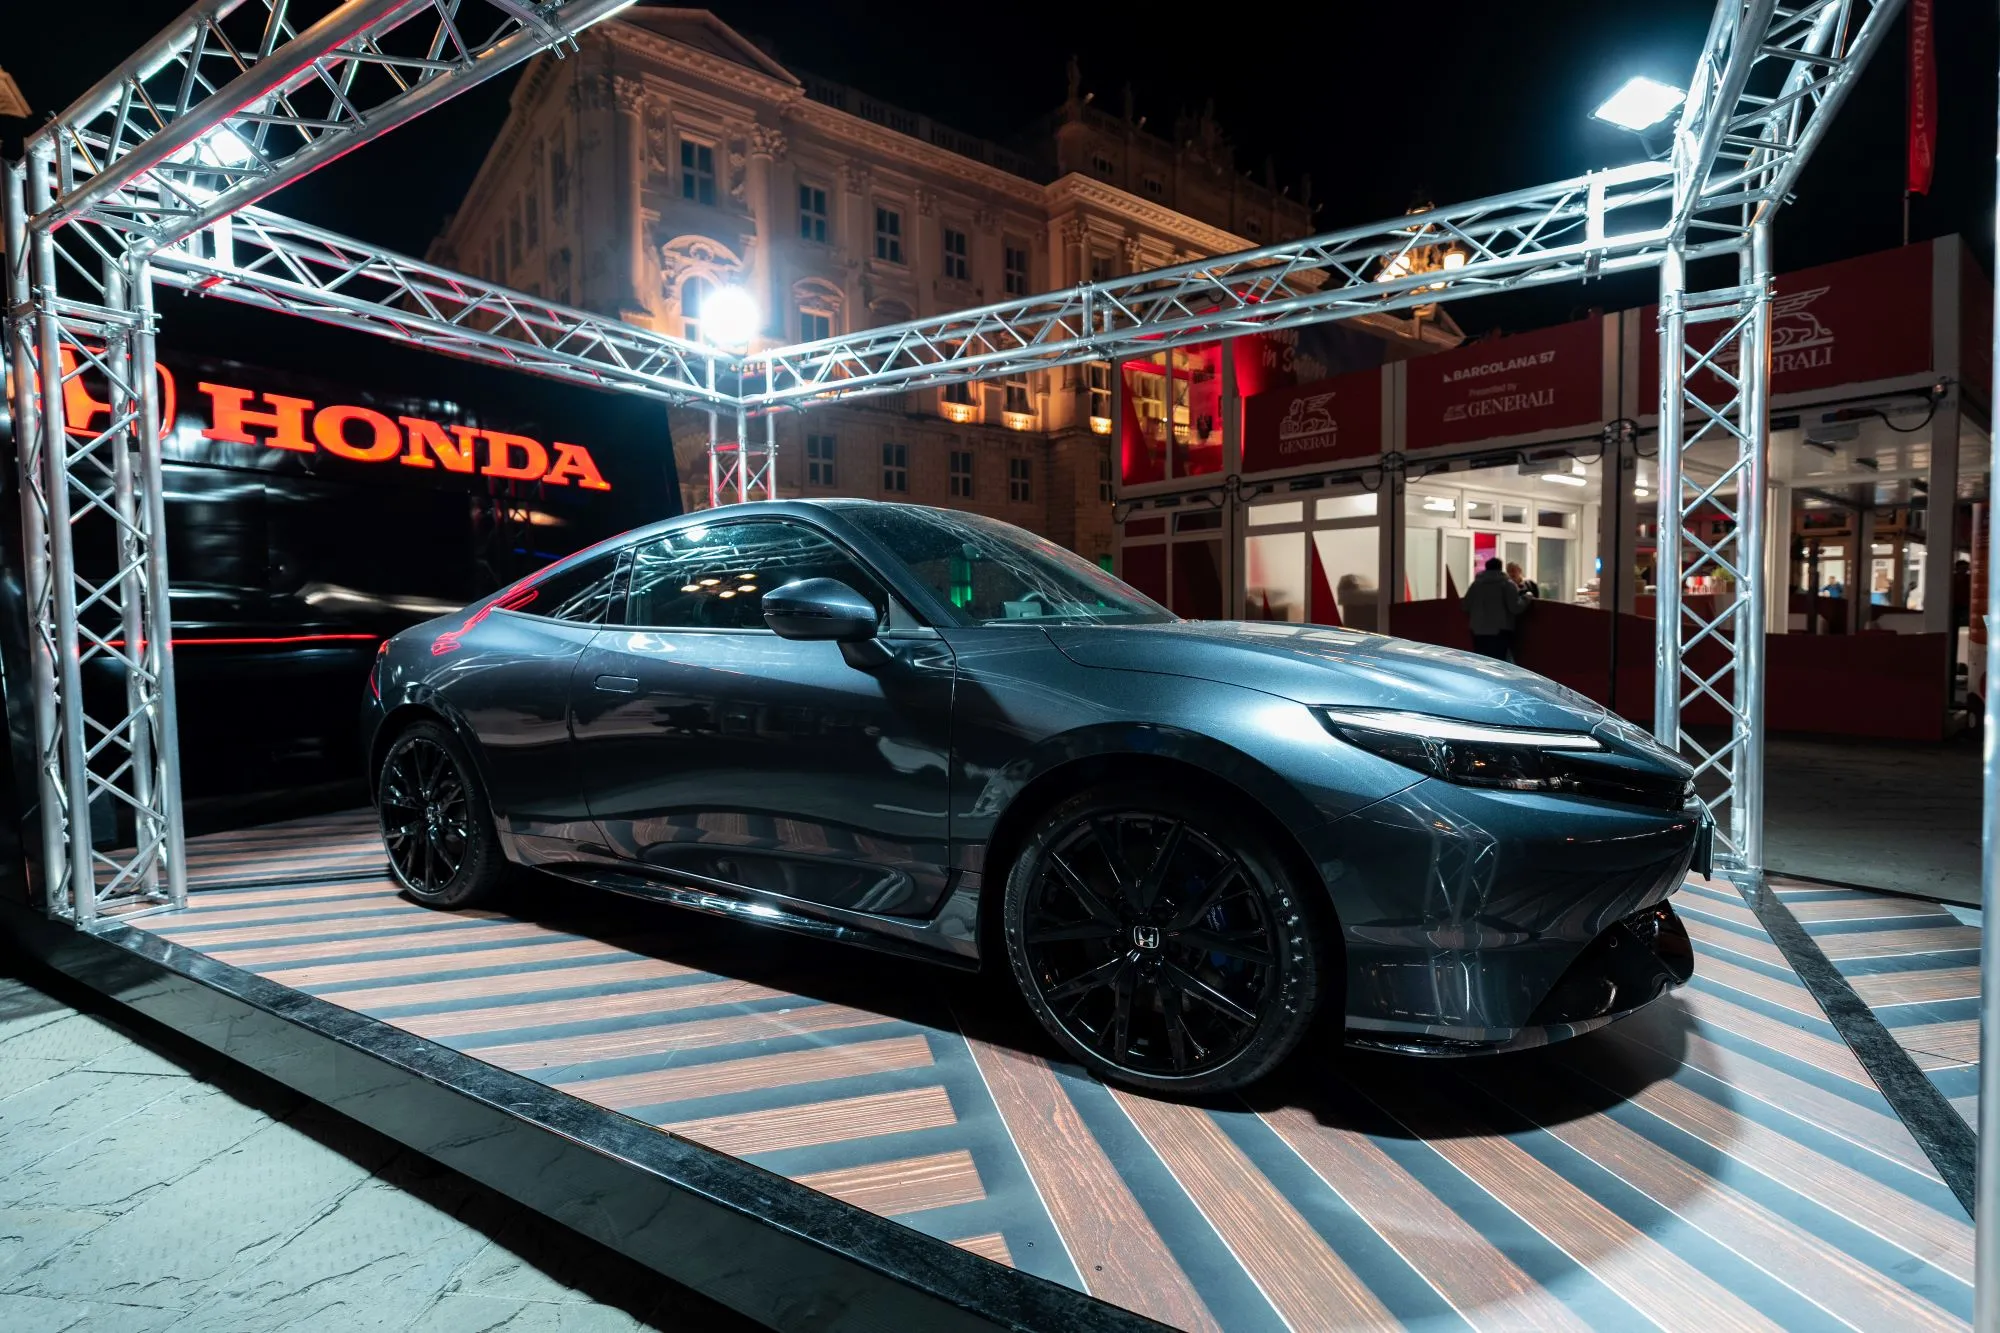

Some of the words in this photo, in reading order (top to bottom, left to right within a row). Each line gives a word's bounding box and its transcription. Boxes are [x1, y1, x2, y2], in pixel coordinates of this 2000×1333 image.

[1262, 343, 1277, 368] in
[1453, 353, 1537, 381] BARCOLANA
[1467, 388, 1555, 418] GENERALI
[198, 380, 611, 491] HONDA
[1279, 433, 1337, 456] GENERALI
